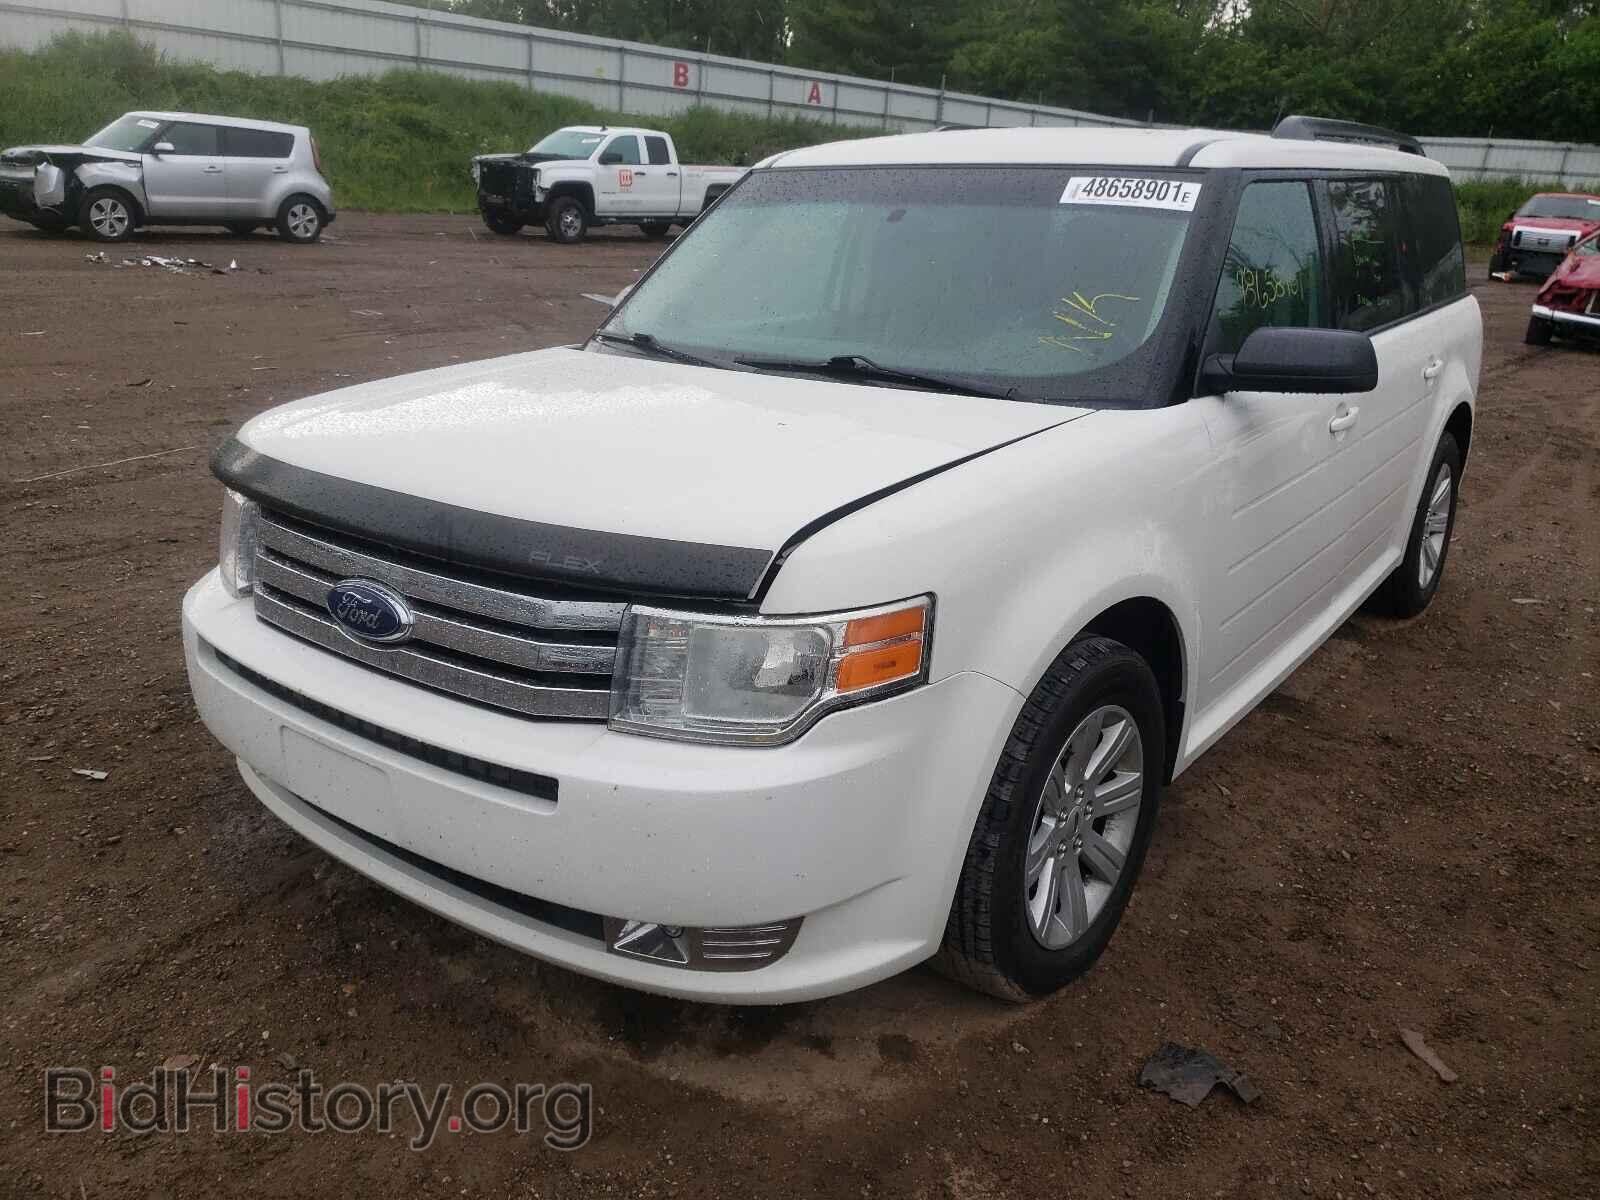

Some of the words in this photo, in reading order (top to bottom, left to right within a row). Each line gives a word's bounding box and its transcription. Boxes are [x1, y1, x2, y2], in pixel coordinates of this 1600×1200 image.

[673, 62, 689, 88] B
[808, 80, 821, 104] A
[1081, 178, 1182, 202] 48658901
[529, 551, 601, 574] FLEX
[336, 590, 383, 629] Ford
